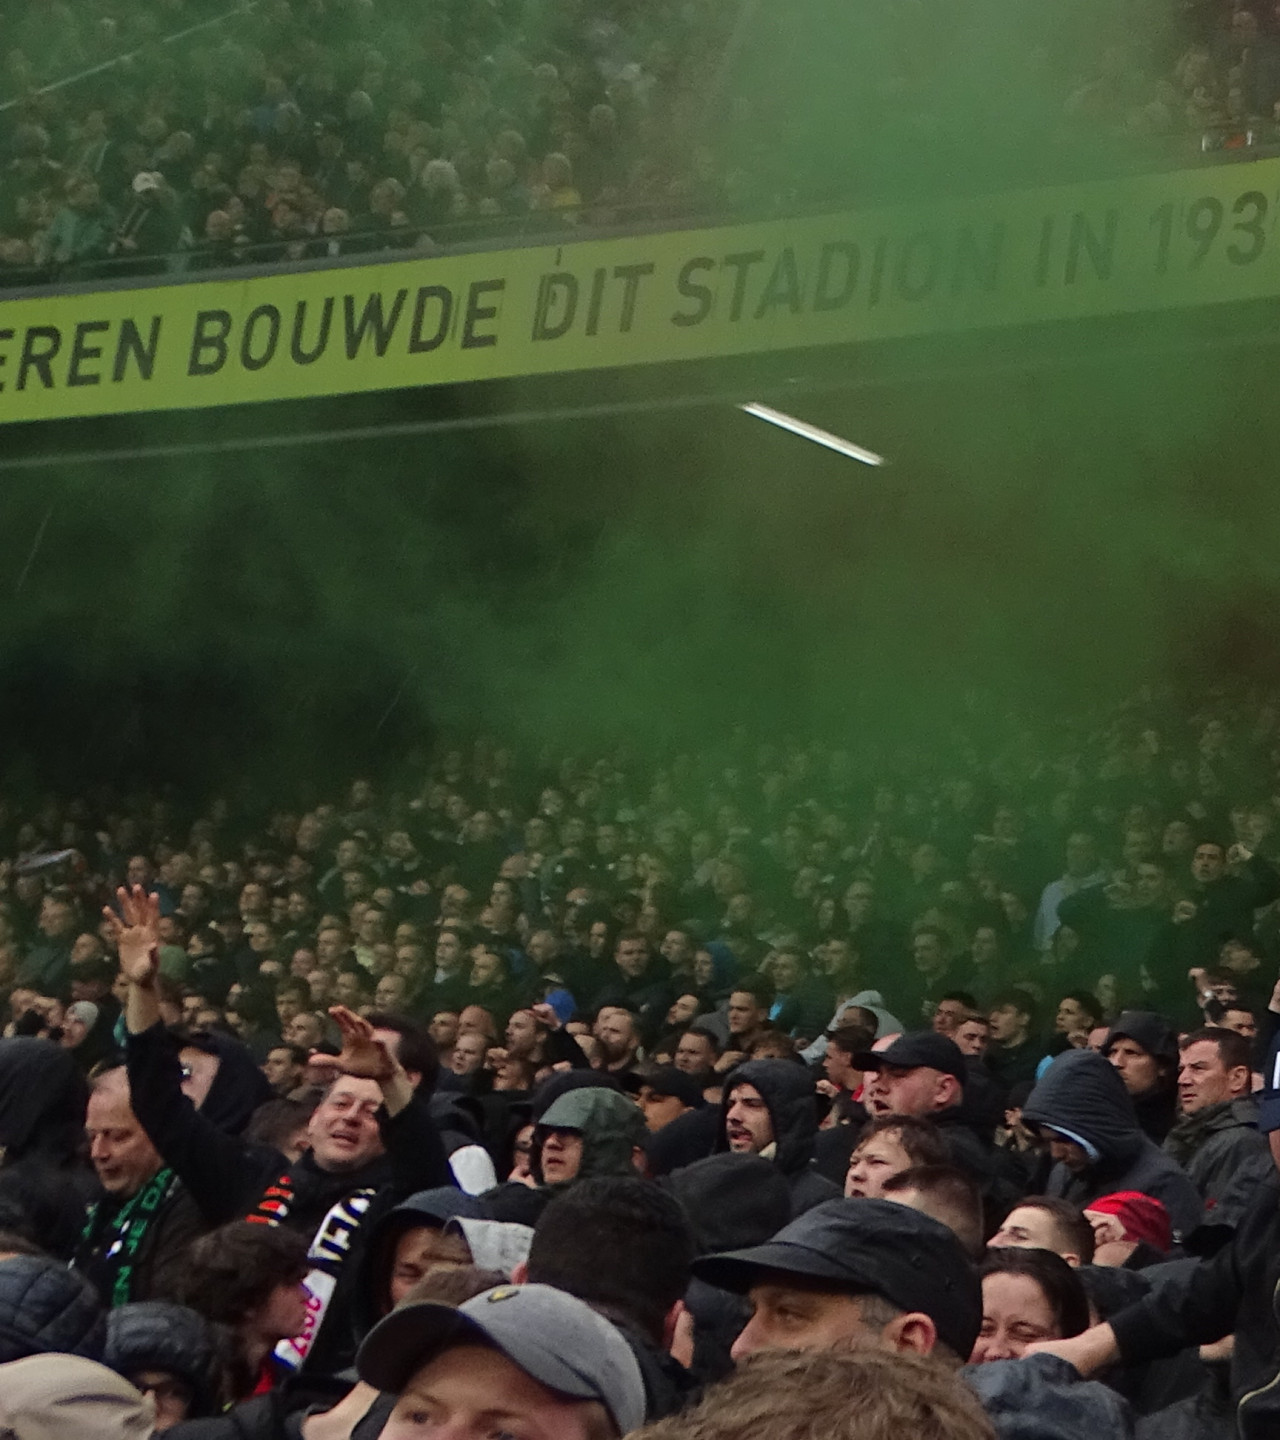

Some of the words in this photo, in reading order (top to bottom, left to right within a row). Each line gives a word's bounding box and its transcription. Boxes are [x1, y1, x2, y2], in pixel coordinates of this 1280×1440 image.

[187, 277, 505, 377] BOUWDE
[531, 262, 654, 343] DIT
[670, 222, 1004, 328] STADION
[1034, 208, 1120, 288] IN
